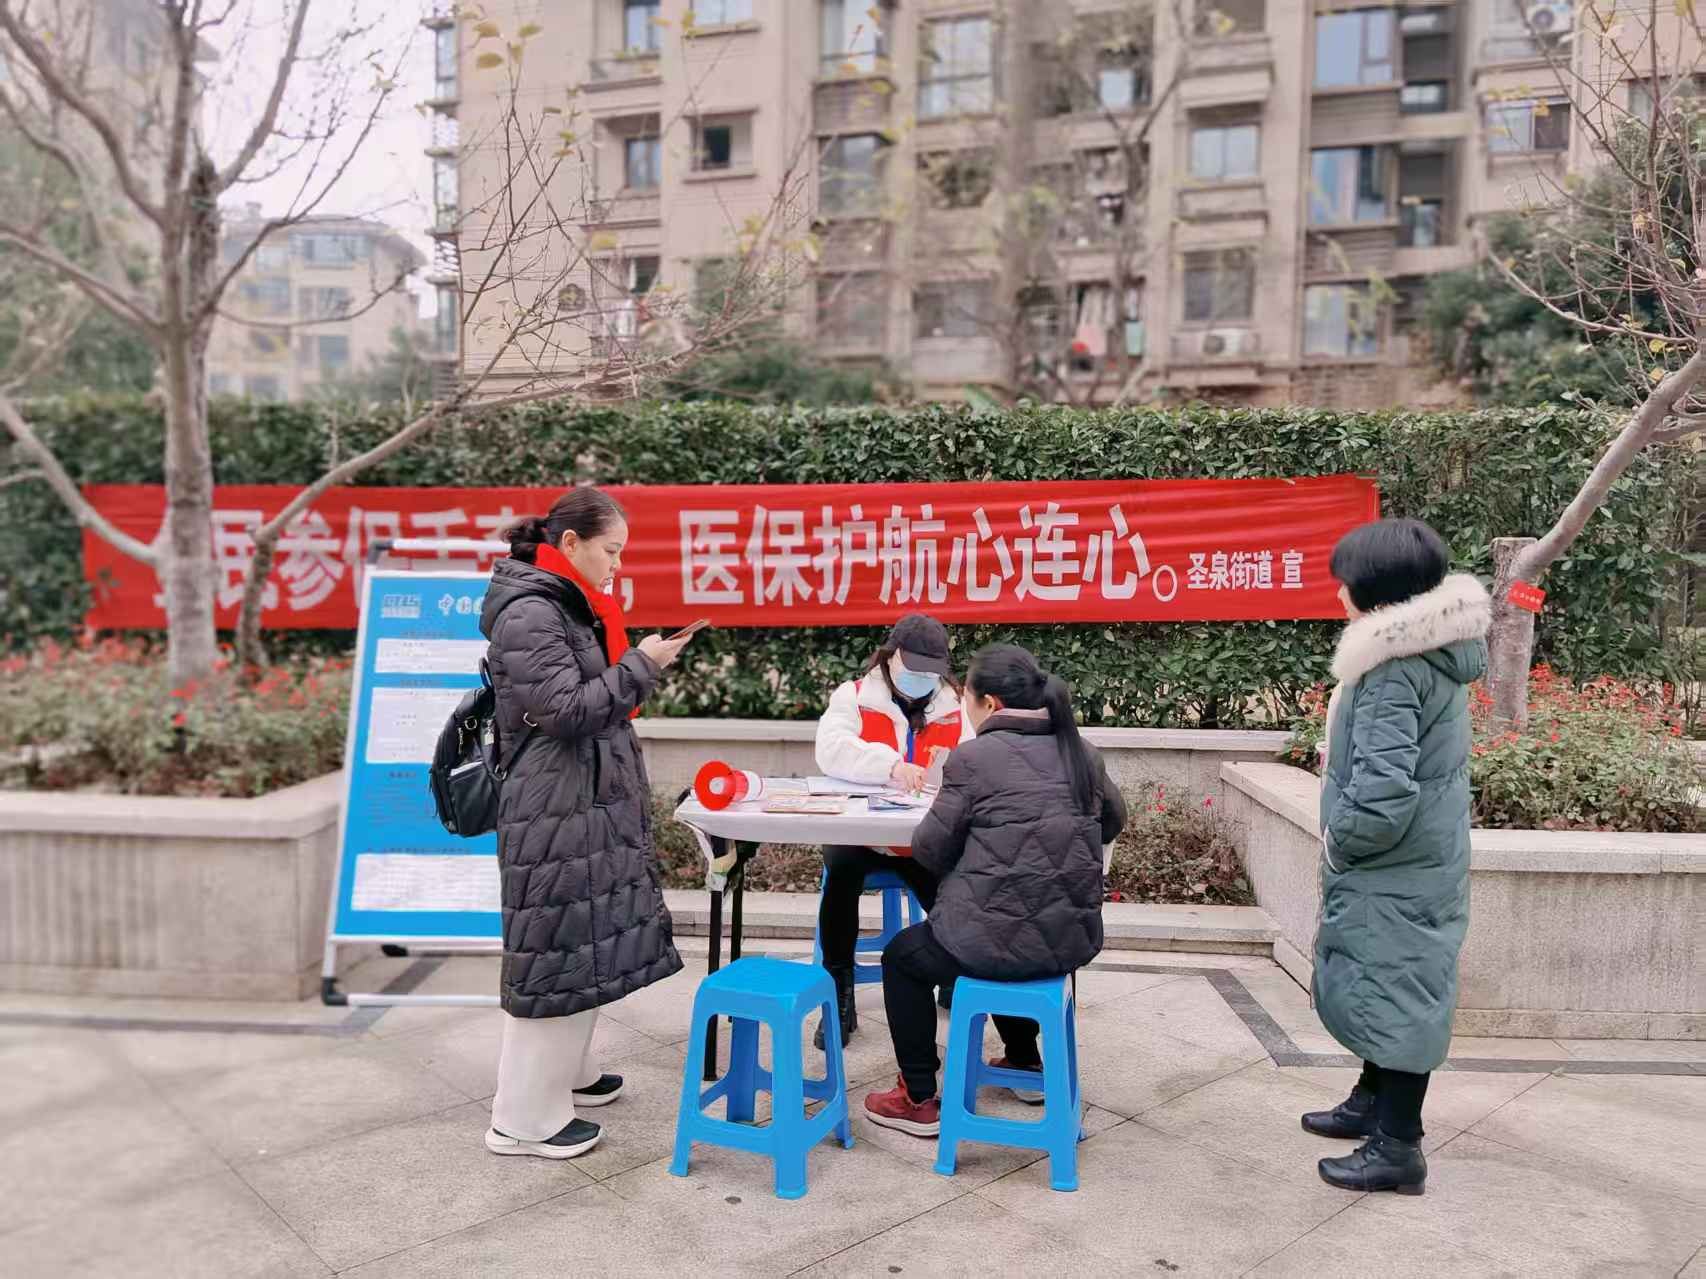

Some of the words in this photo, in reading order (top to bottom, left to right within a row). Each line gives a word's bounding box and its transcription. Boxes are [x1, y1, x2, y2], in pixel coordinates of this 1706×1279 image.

[1187, 550, 1273, 591] 圣泉街道
[1281, 550, 1304, 590] 宣
